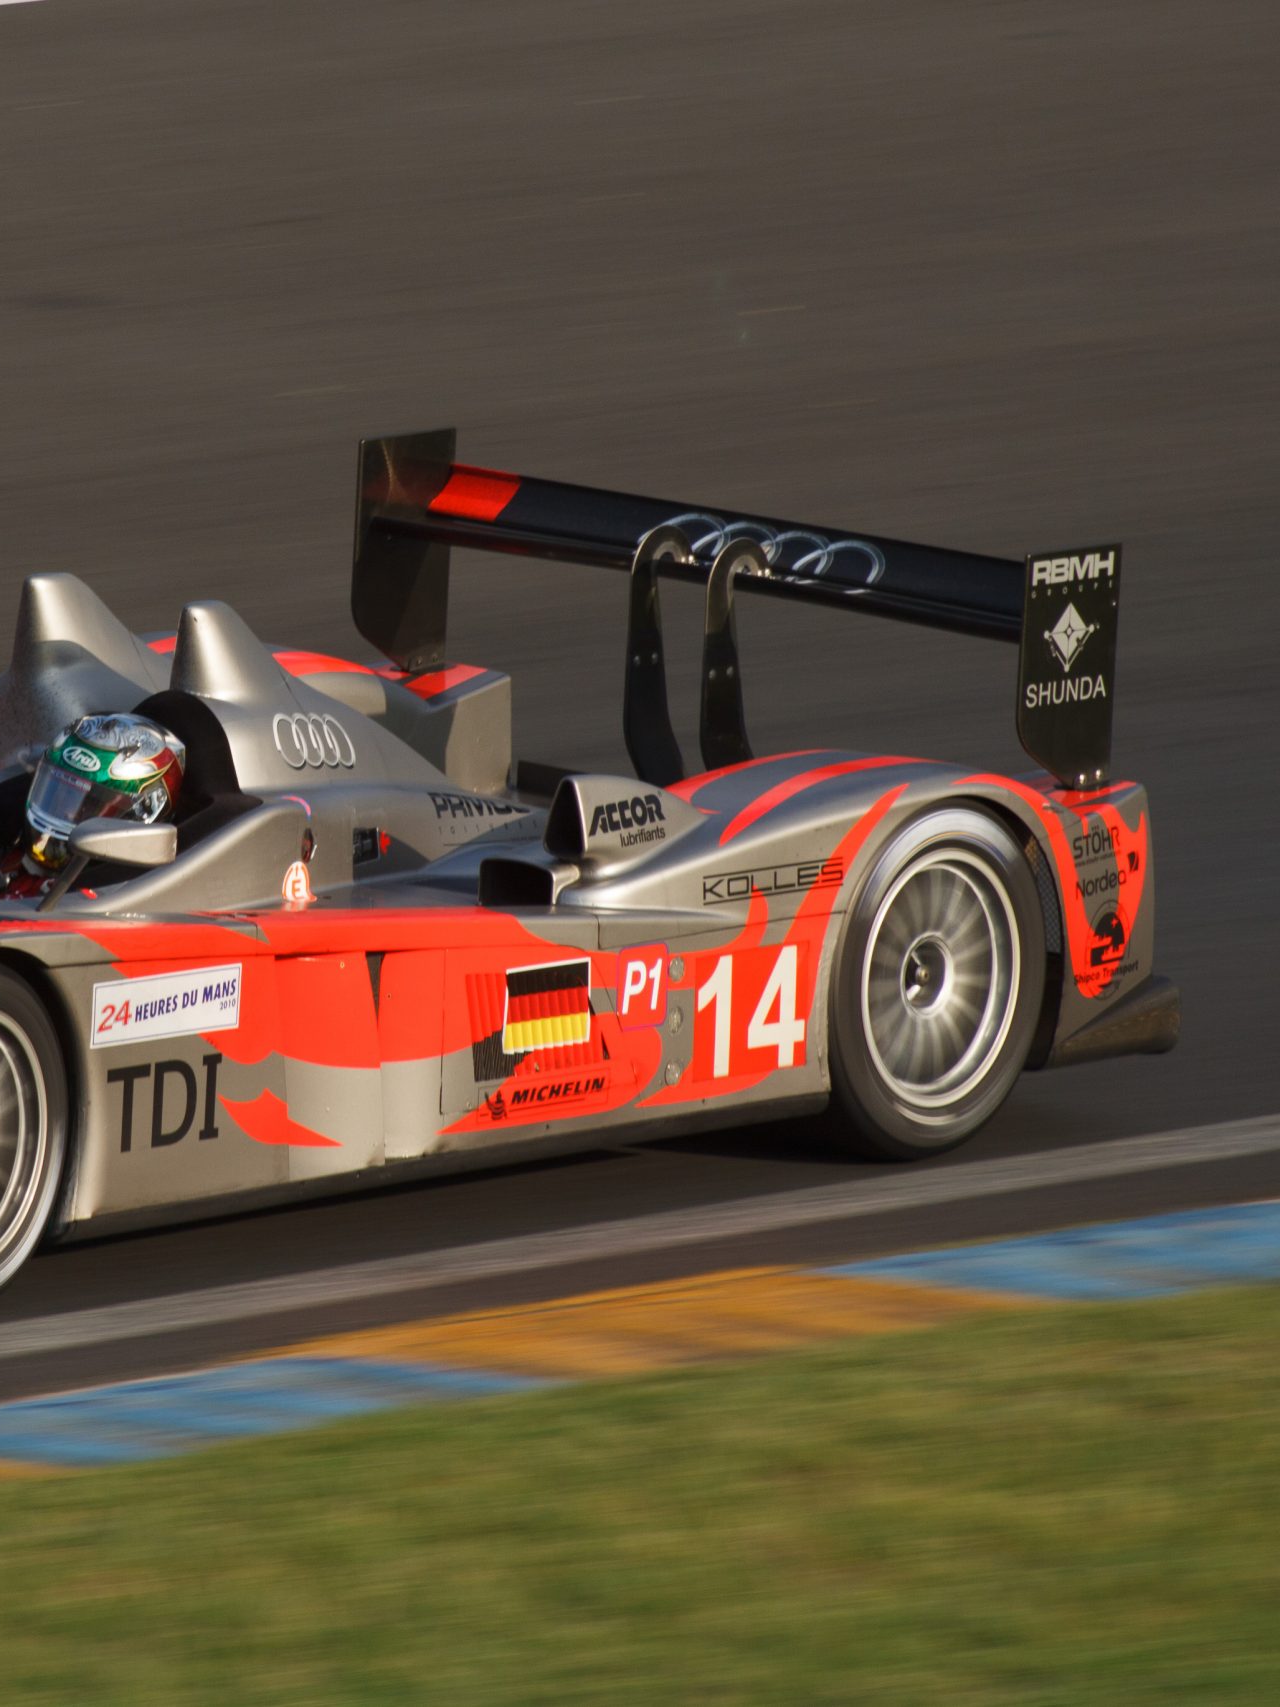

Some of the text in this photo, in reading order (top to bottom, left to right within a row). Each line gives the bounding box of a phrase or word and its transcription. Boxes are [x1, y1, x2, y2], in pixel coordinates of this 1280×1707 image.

[1032, 551, 1115, 586] RBMH
[1025, 674, 1106, 708] SHUNDA
[69, 748, 97, 768] Arai
[589, 794, 666, 836] ACCOR
[620, 826, 666, 848] lubrifiants
[703, 861, 843, 901] KOLLES
[1075, 869, 1127, 900] Nordea
[622, 958, 663, 1015] P1
[97, 978, 237, 1033] 24 HEURES DU MANS
[220, 1000, 236, 1010] 2010
[698, 945, 805, 1078] 14
[107, 1052, 222, 1153] TDI
[511, 1077, 605, 1105] MICHELIN
